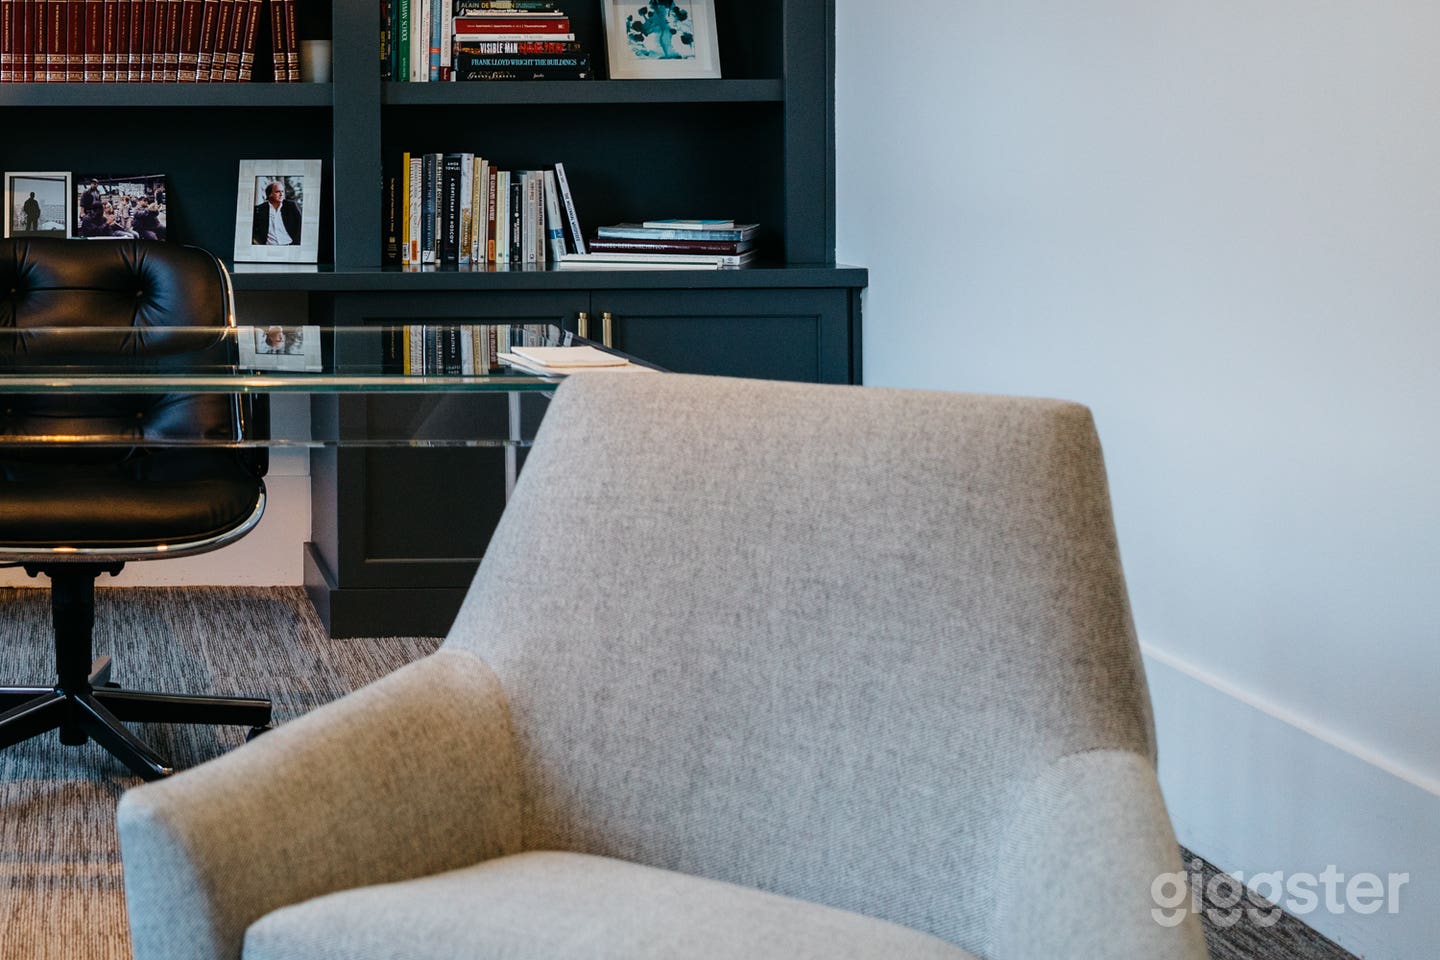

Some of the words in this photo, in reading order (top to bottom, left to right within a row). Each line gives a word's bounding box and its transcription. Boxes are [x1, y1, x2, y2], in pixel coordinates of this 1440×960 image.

[480, 42, 503, 54] VISIBLE
[504, 42, 518, 54] MAN
[471, 58, 491, 66] FRANK
[491, 58, 510, 66] LLOYD
[510, 58, 534, 66] WRIGHT
[546, 58, 577, 66] BUILDINGS
